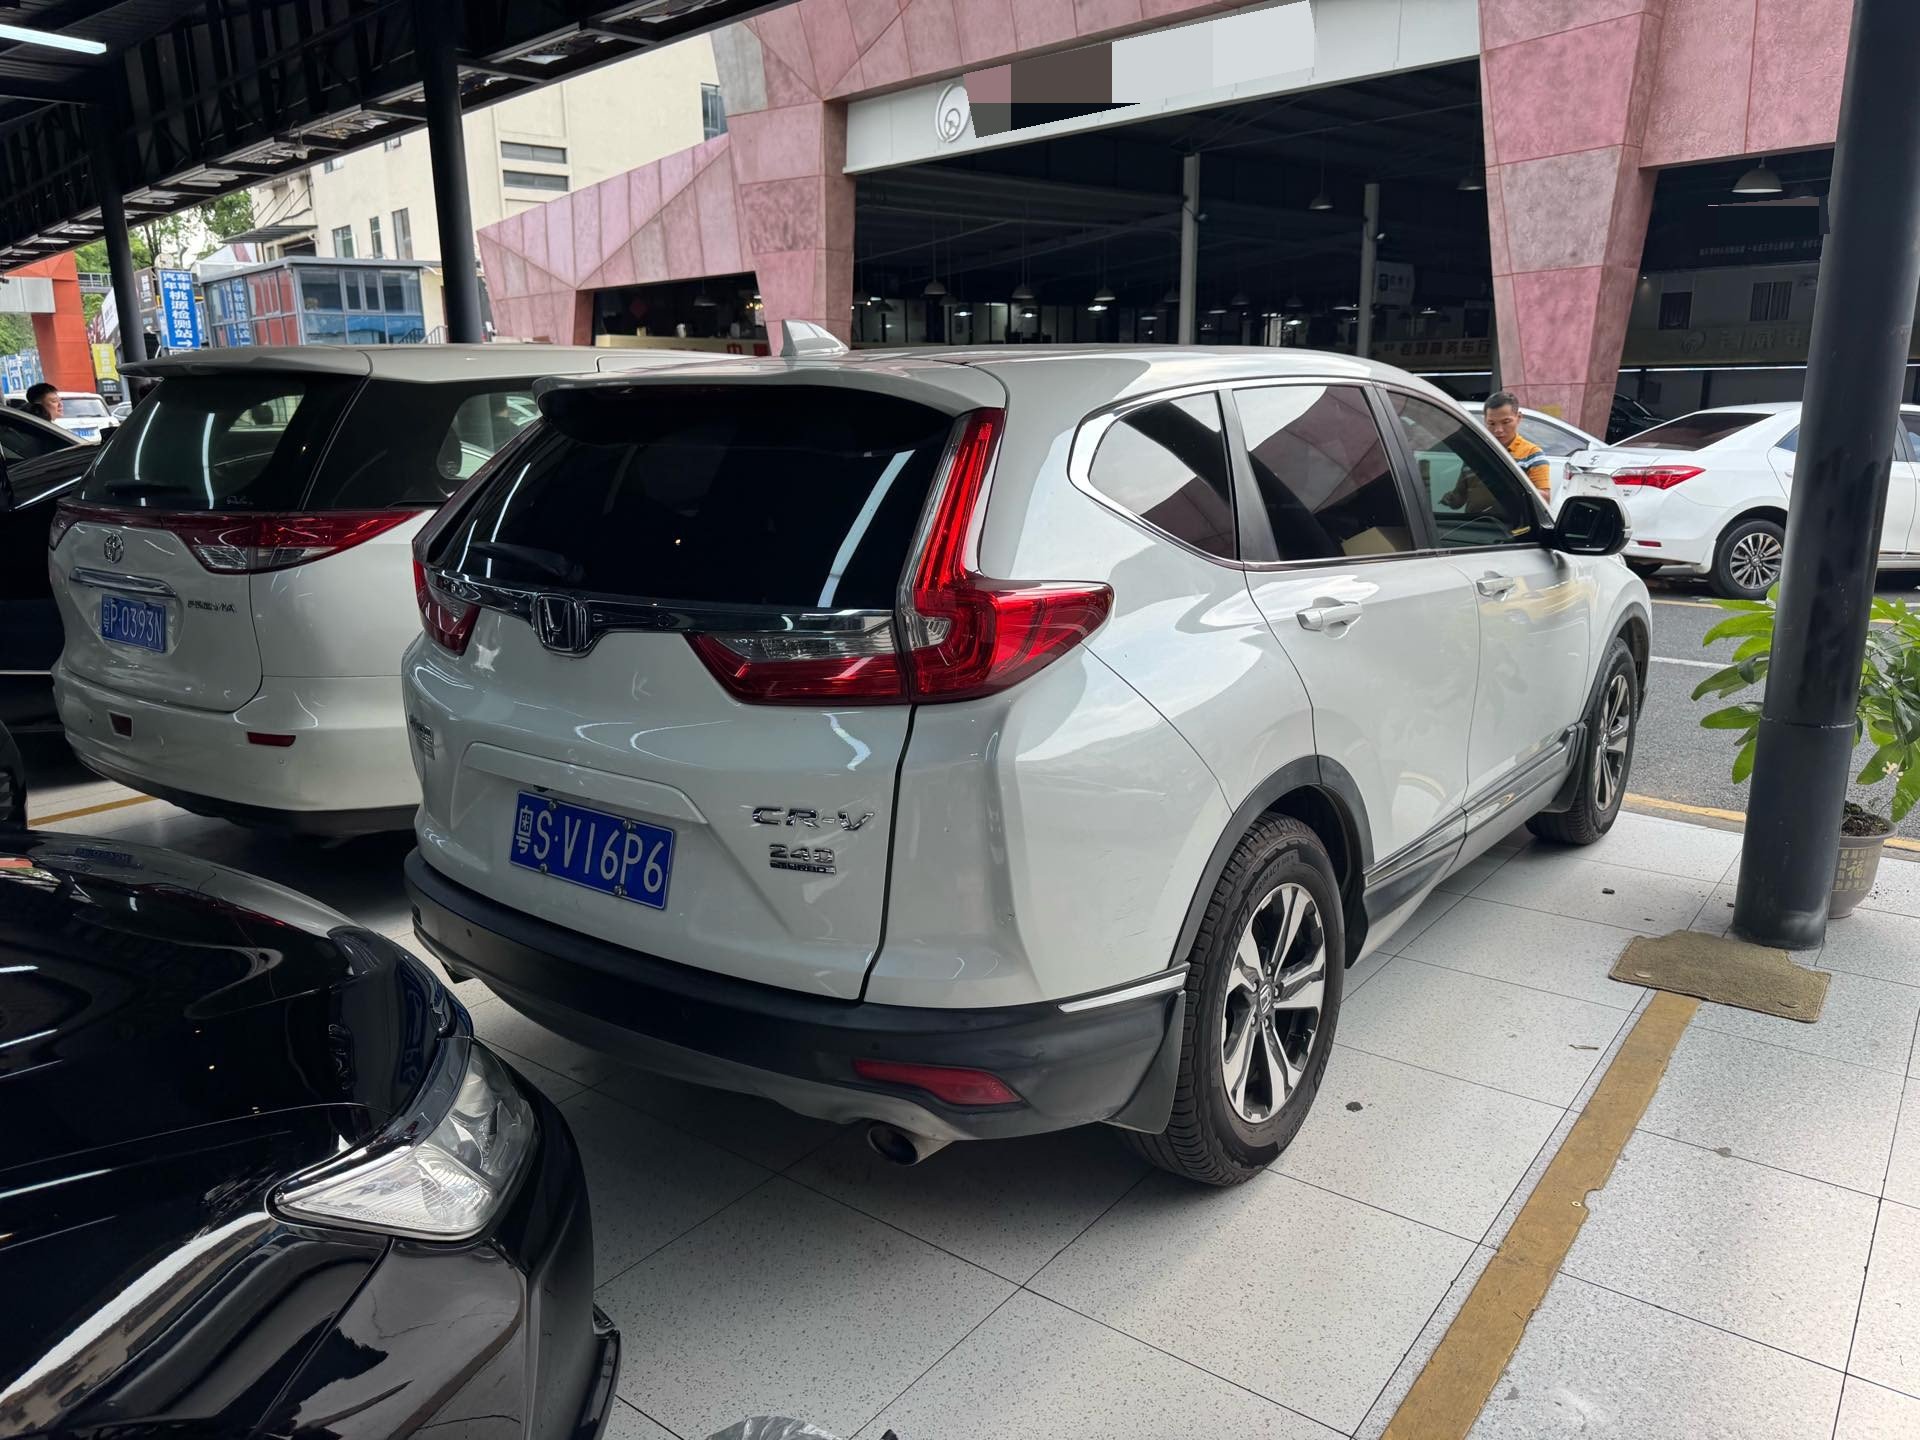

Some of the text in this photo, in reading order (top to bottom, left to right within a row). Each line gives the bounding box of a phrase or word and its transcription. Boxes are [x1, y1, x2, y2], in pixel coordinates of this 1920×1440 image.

[169, 290, 194, 339] 桃源检测站
[752, 807, 875, 831] CR-V
